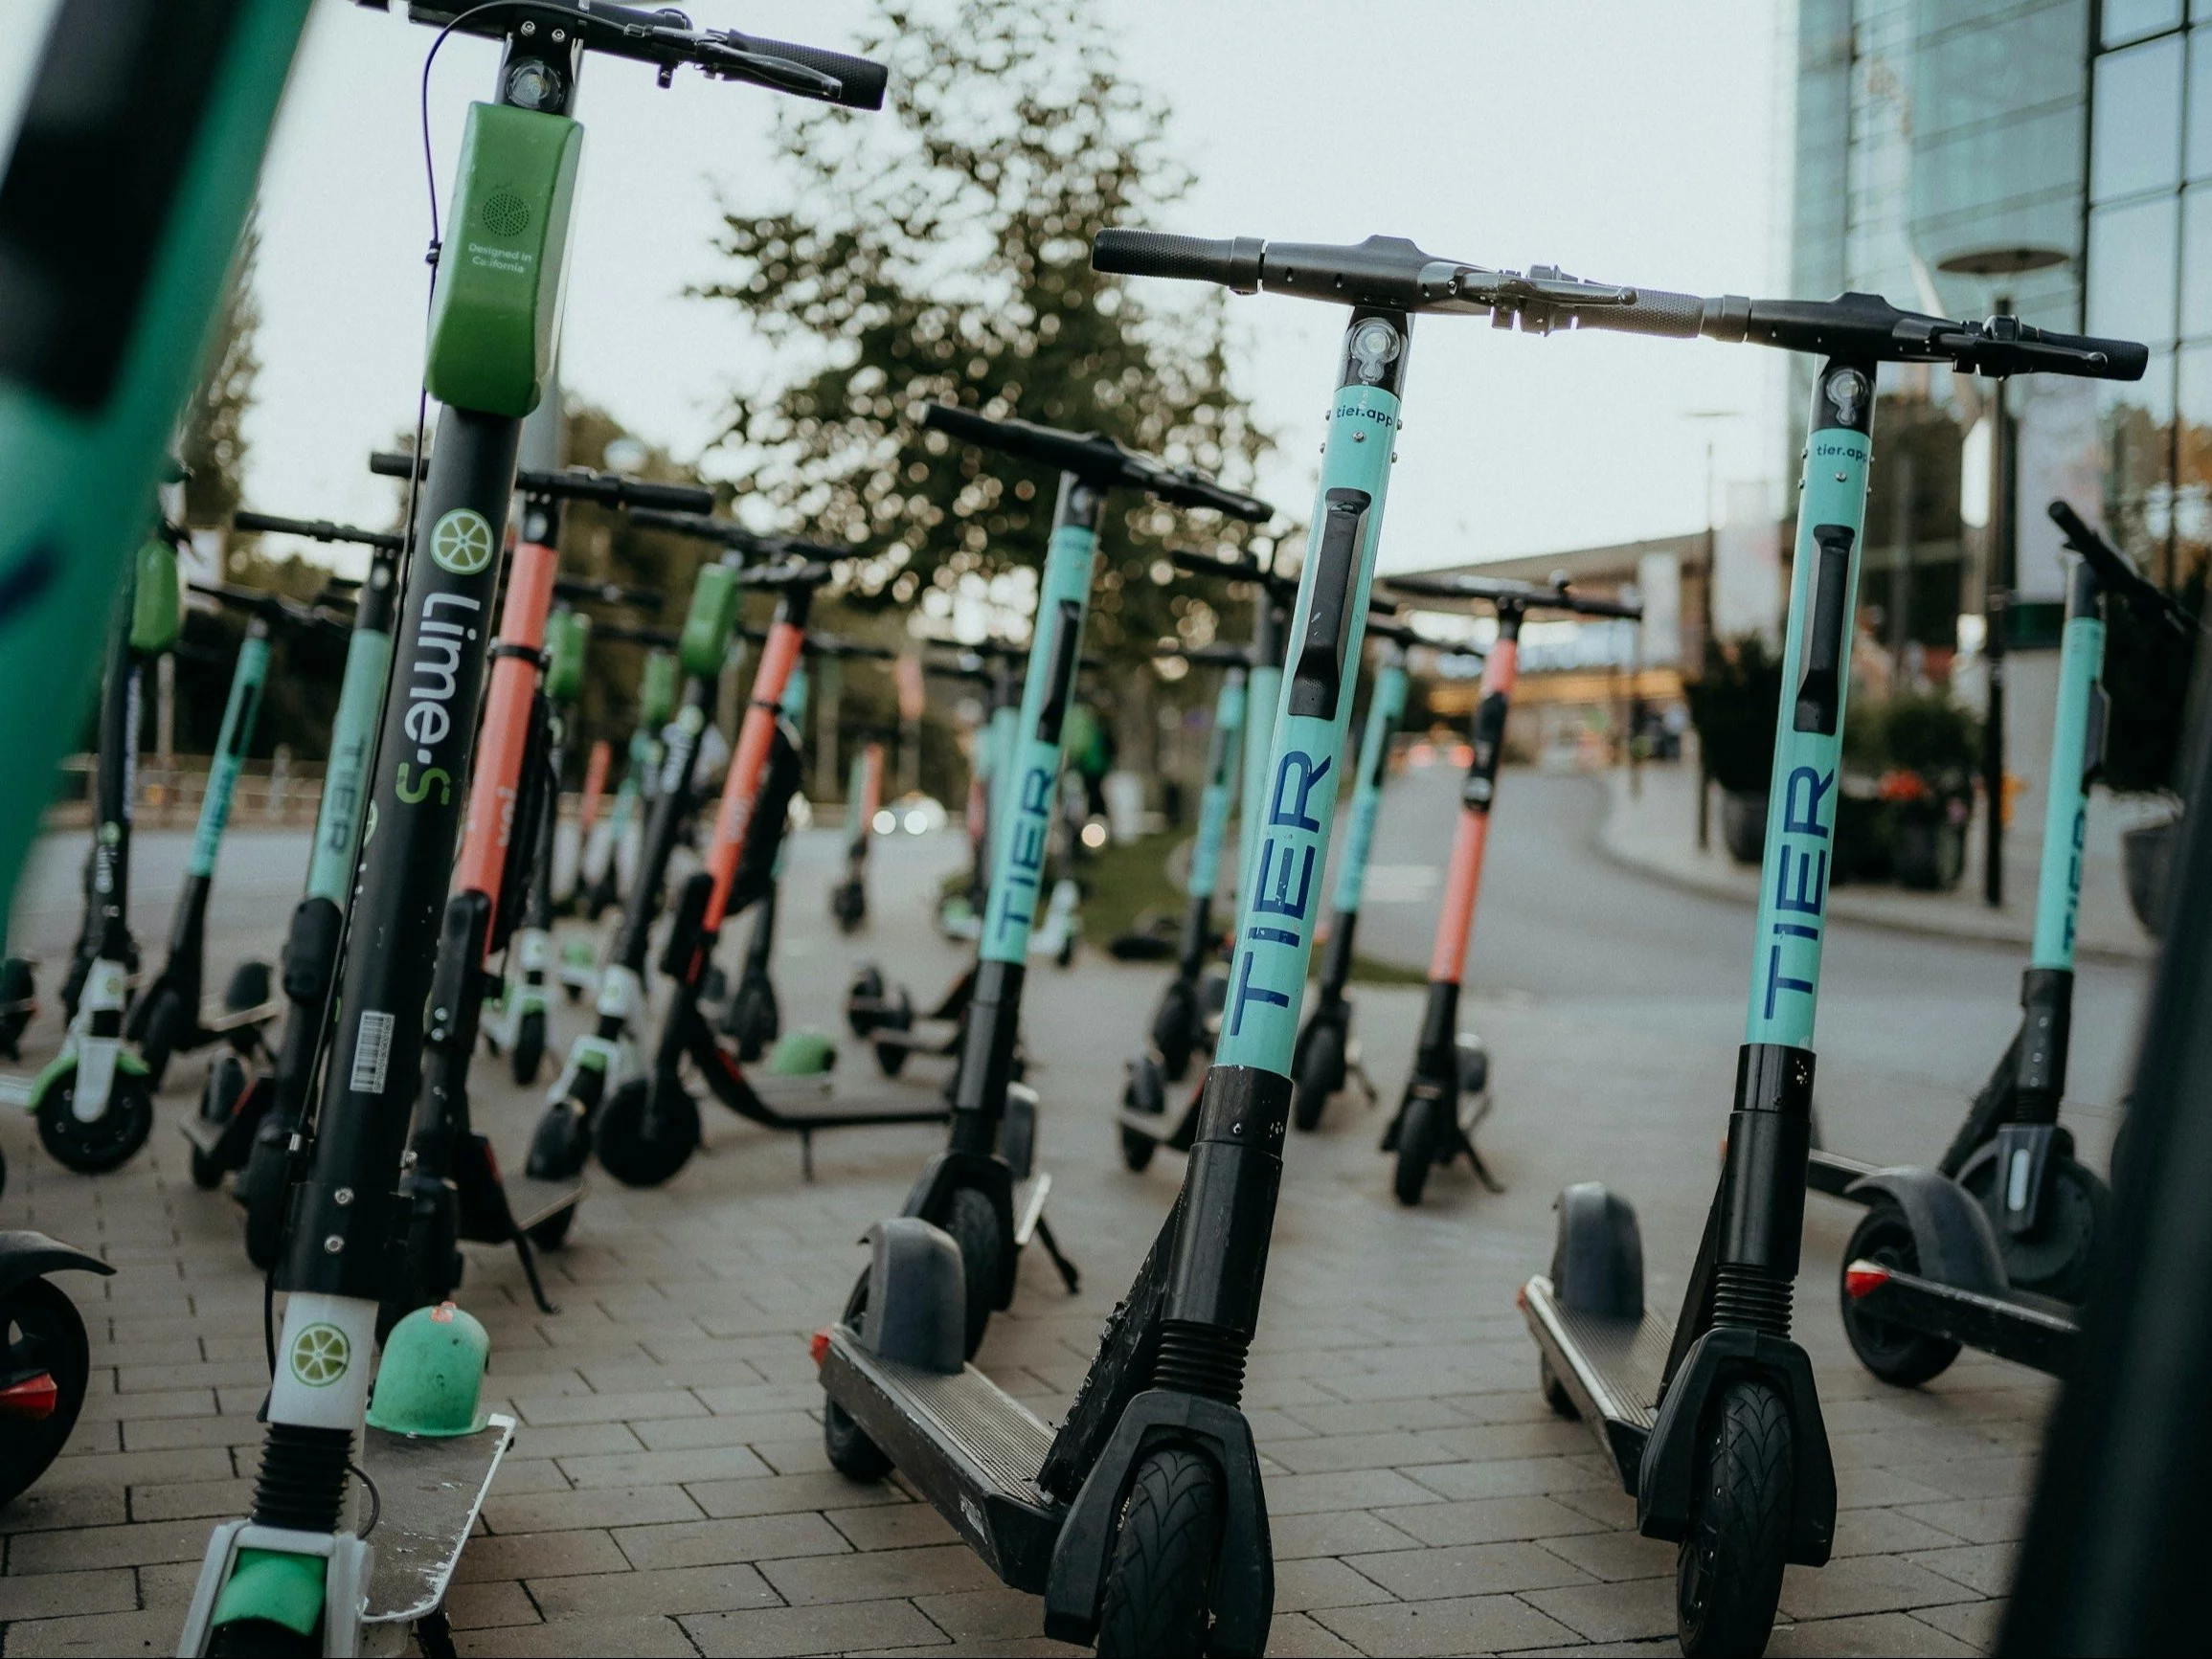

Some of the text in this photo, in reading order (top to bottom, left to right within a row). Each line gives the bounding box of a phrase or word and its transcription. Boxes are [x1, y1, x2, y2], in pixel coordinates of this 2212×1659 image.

[469, 243, 532, 262] Designed in
[472, 256, 524, 273] Caifornia
[1337, 405, 1393, 427] tier.app
[997, 768, 1052, 941] TIER
[1230, 751, 1332, 1037] TIER
[1764, 765, 1836, 1021] TIER
